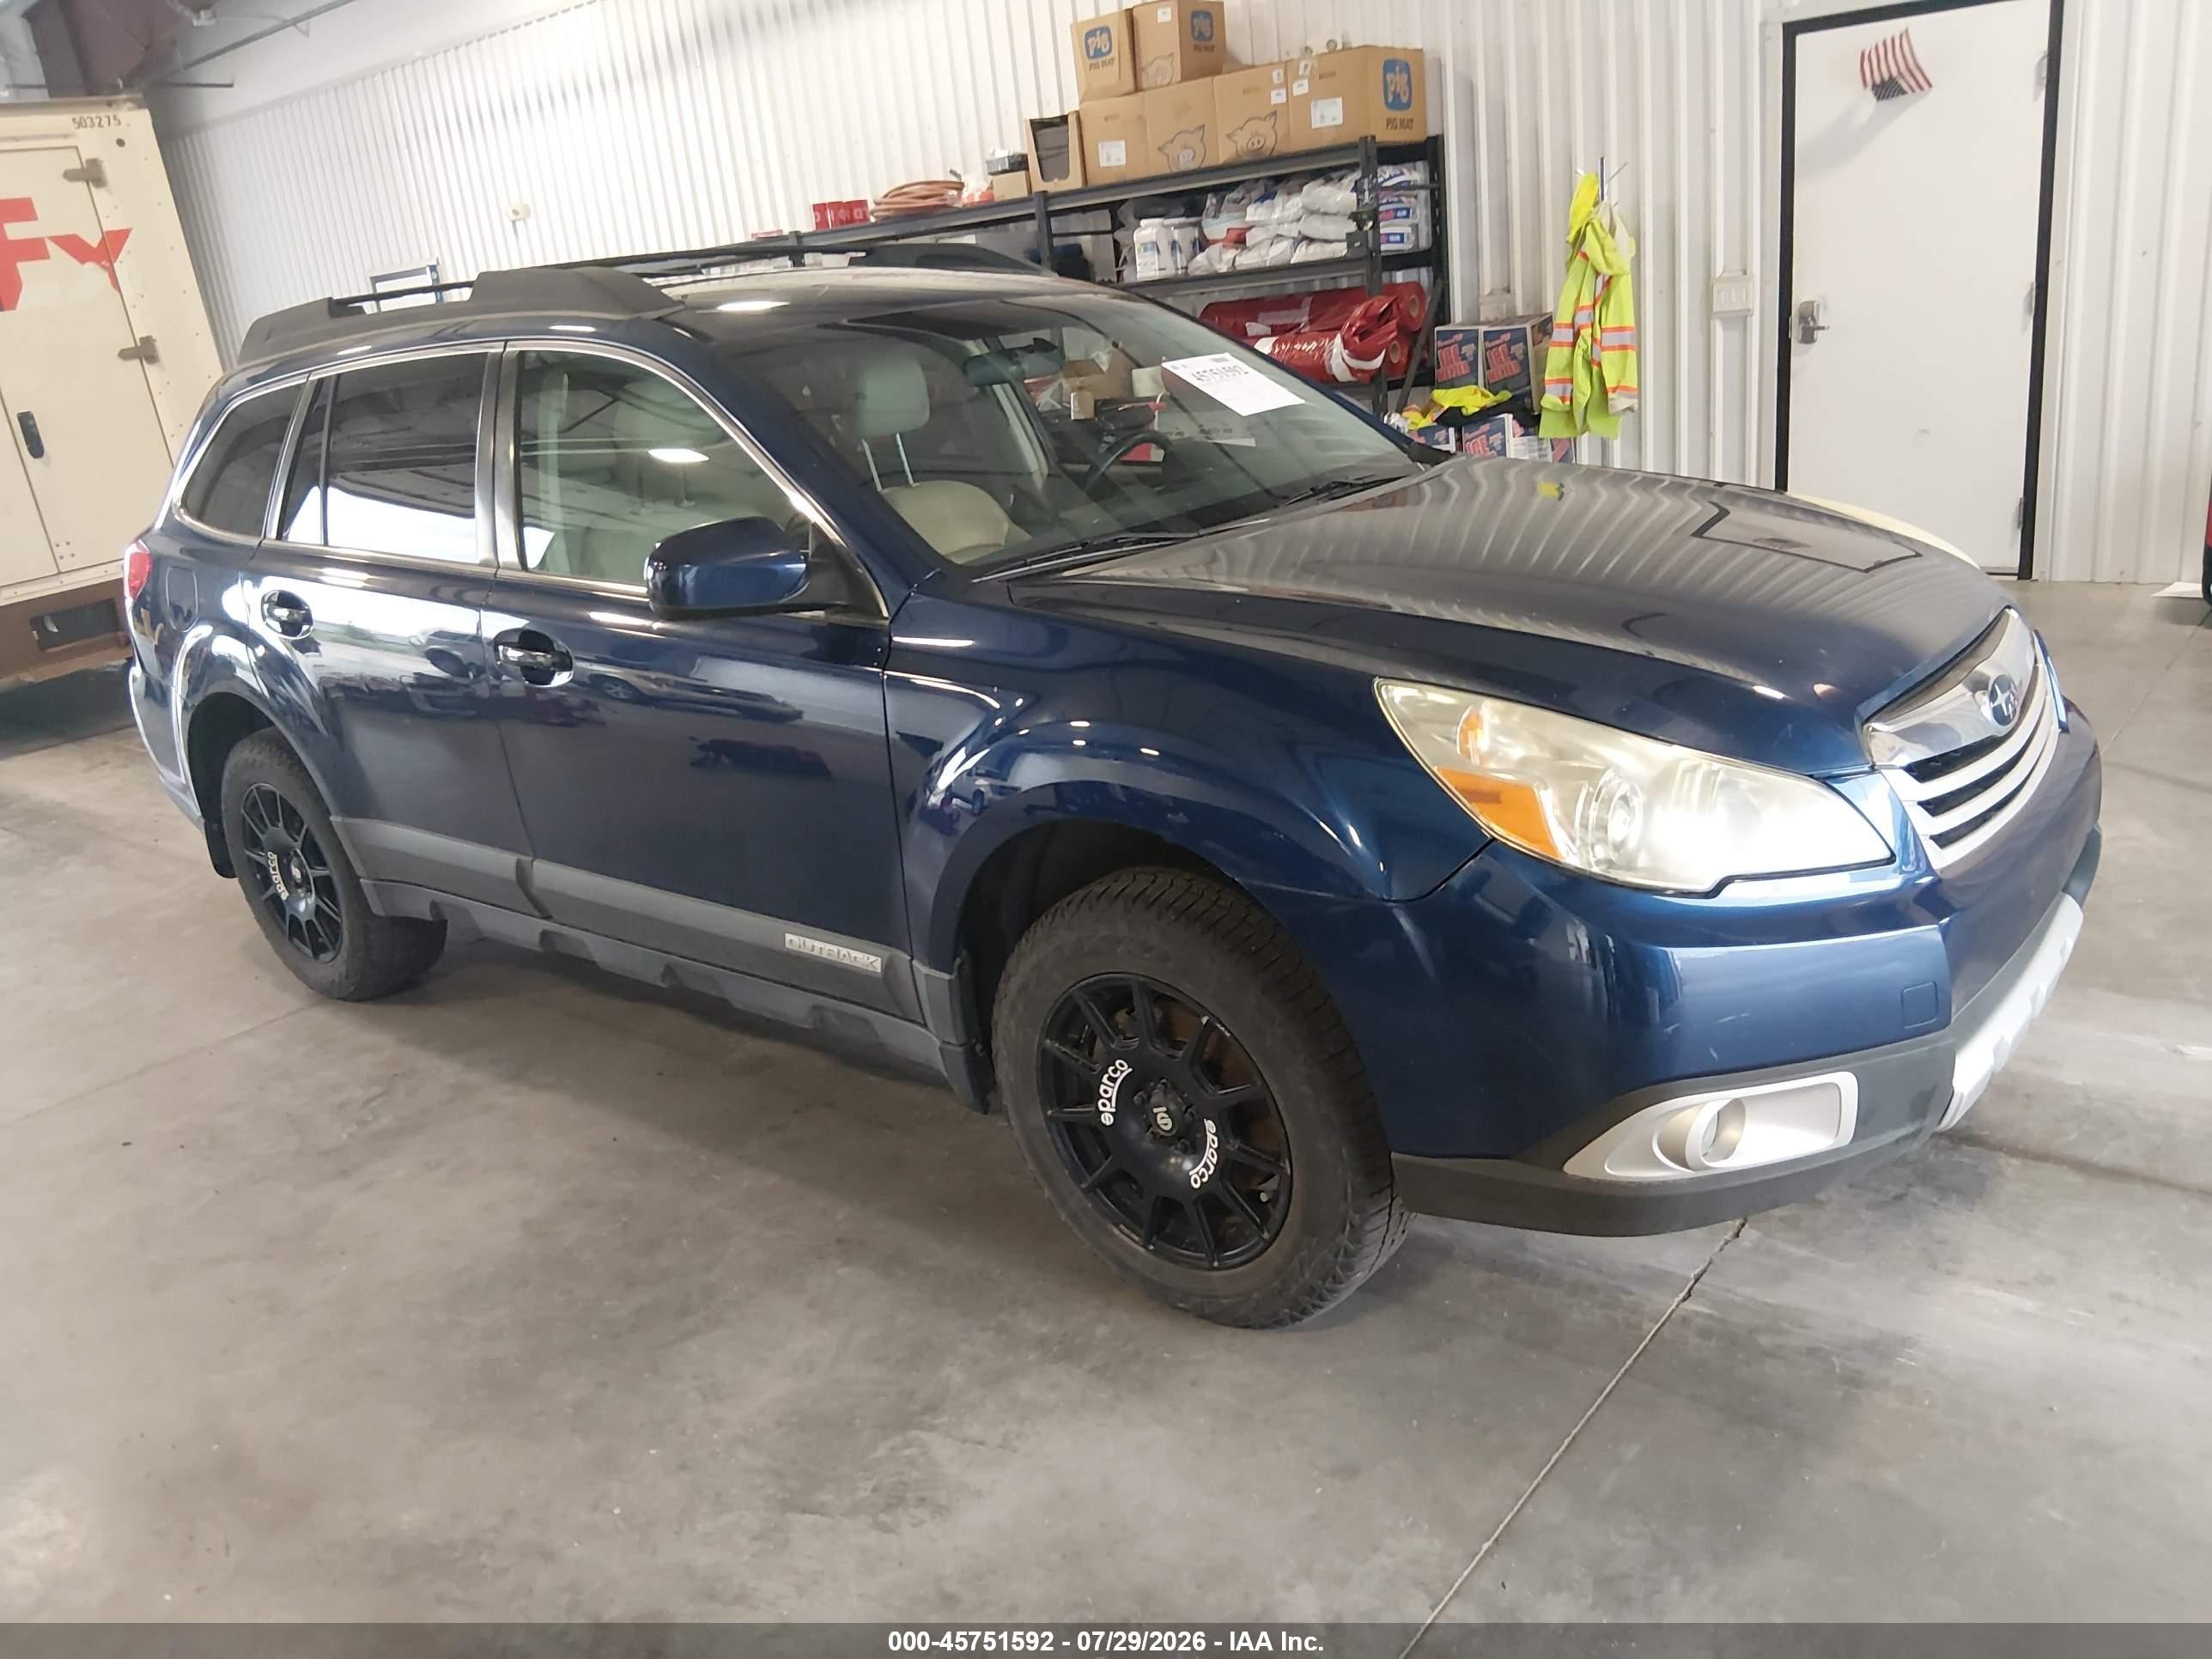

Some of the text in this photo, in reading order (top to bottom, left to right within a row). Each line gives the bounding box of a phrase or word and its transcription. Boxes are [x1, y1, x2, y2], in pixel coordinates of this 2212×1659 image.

[1386, 64, 1409, 104] pig
[72, 114, 122, 129] 503275
[1386, 117, 1413, 131] PIG MAT
[788, 936, 879, 970] OUTBACK
[1097, 1059, 1133, 1126] sparco
[1190, 1119, 1218, 1189] sparco
